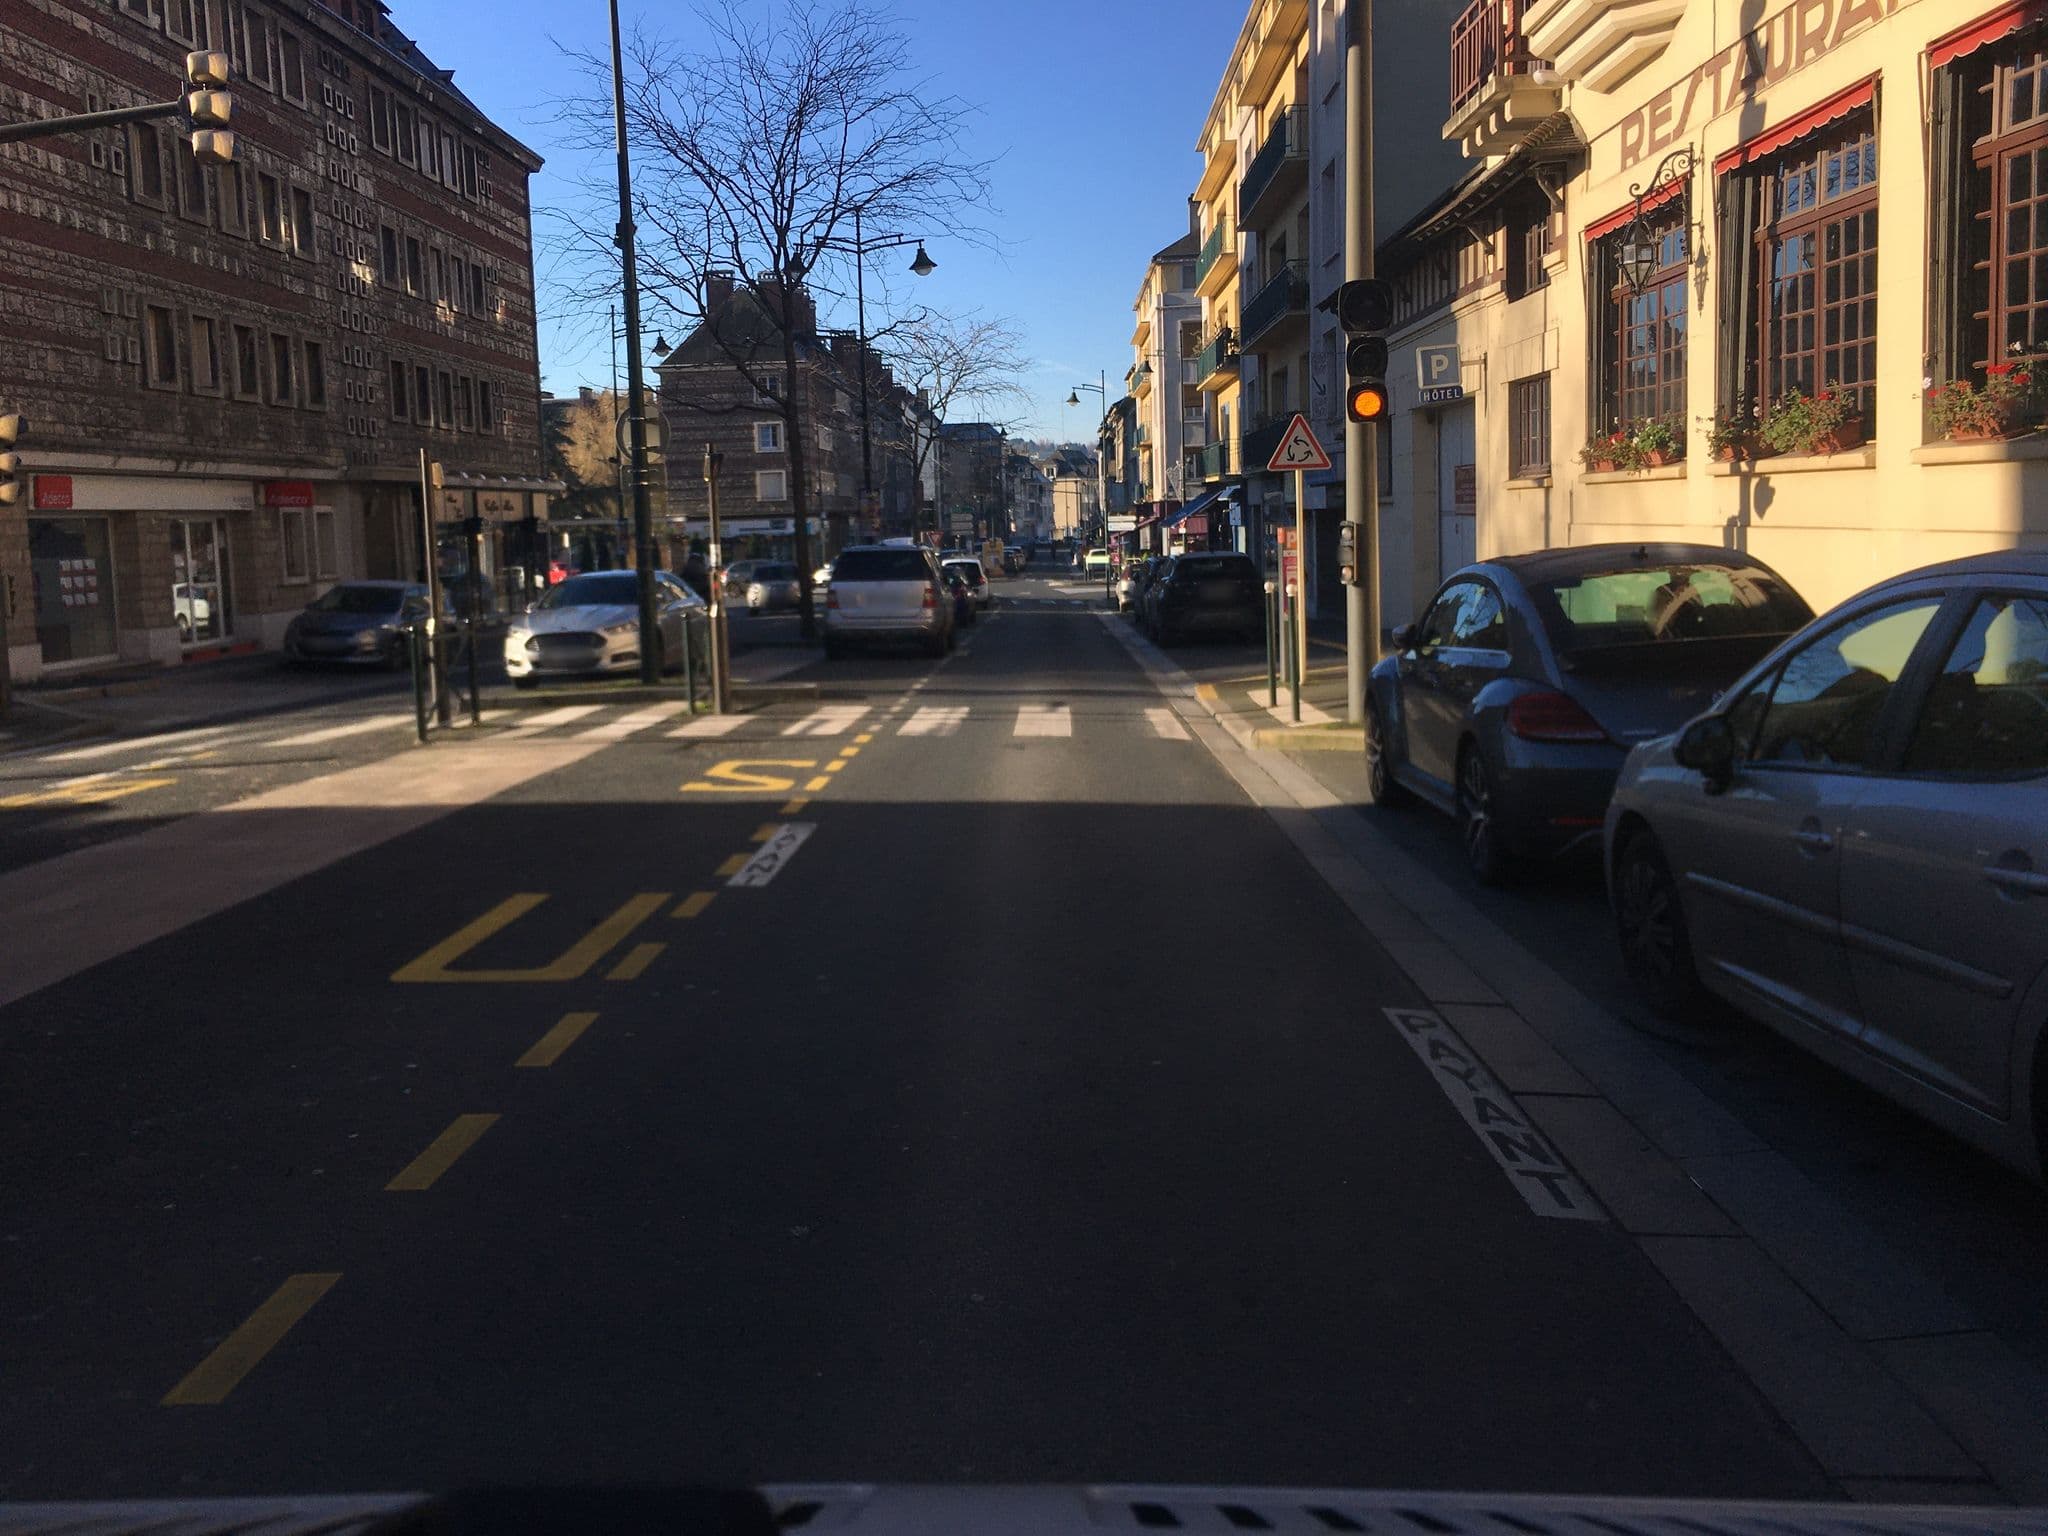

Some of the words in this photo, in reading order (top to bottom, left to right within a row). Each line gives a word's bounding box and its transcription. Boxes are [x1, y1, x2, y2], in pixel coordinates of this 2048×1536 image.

[1620, 0, 1899, 173] RESTAURA
[1423, 387, 1460, 402] HÔTEL
[1430, 354, 1449, 380] P
[1393, 1013, 1577, 1210] PAYANT
